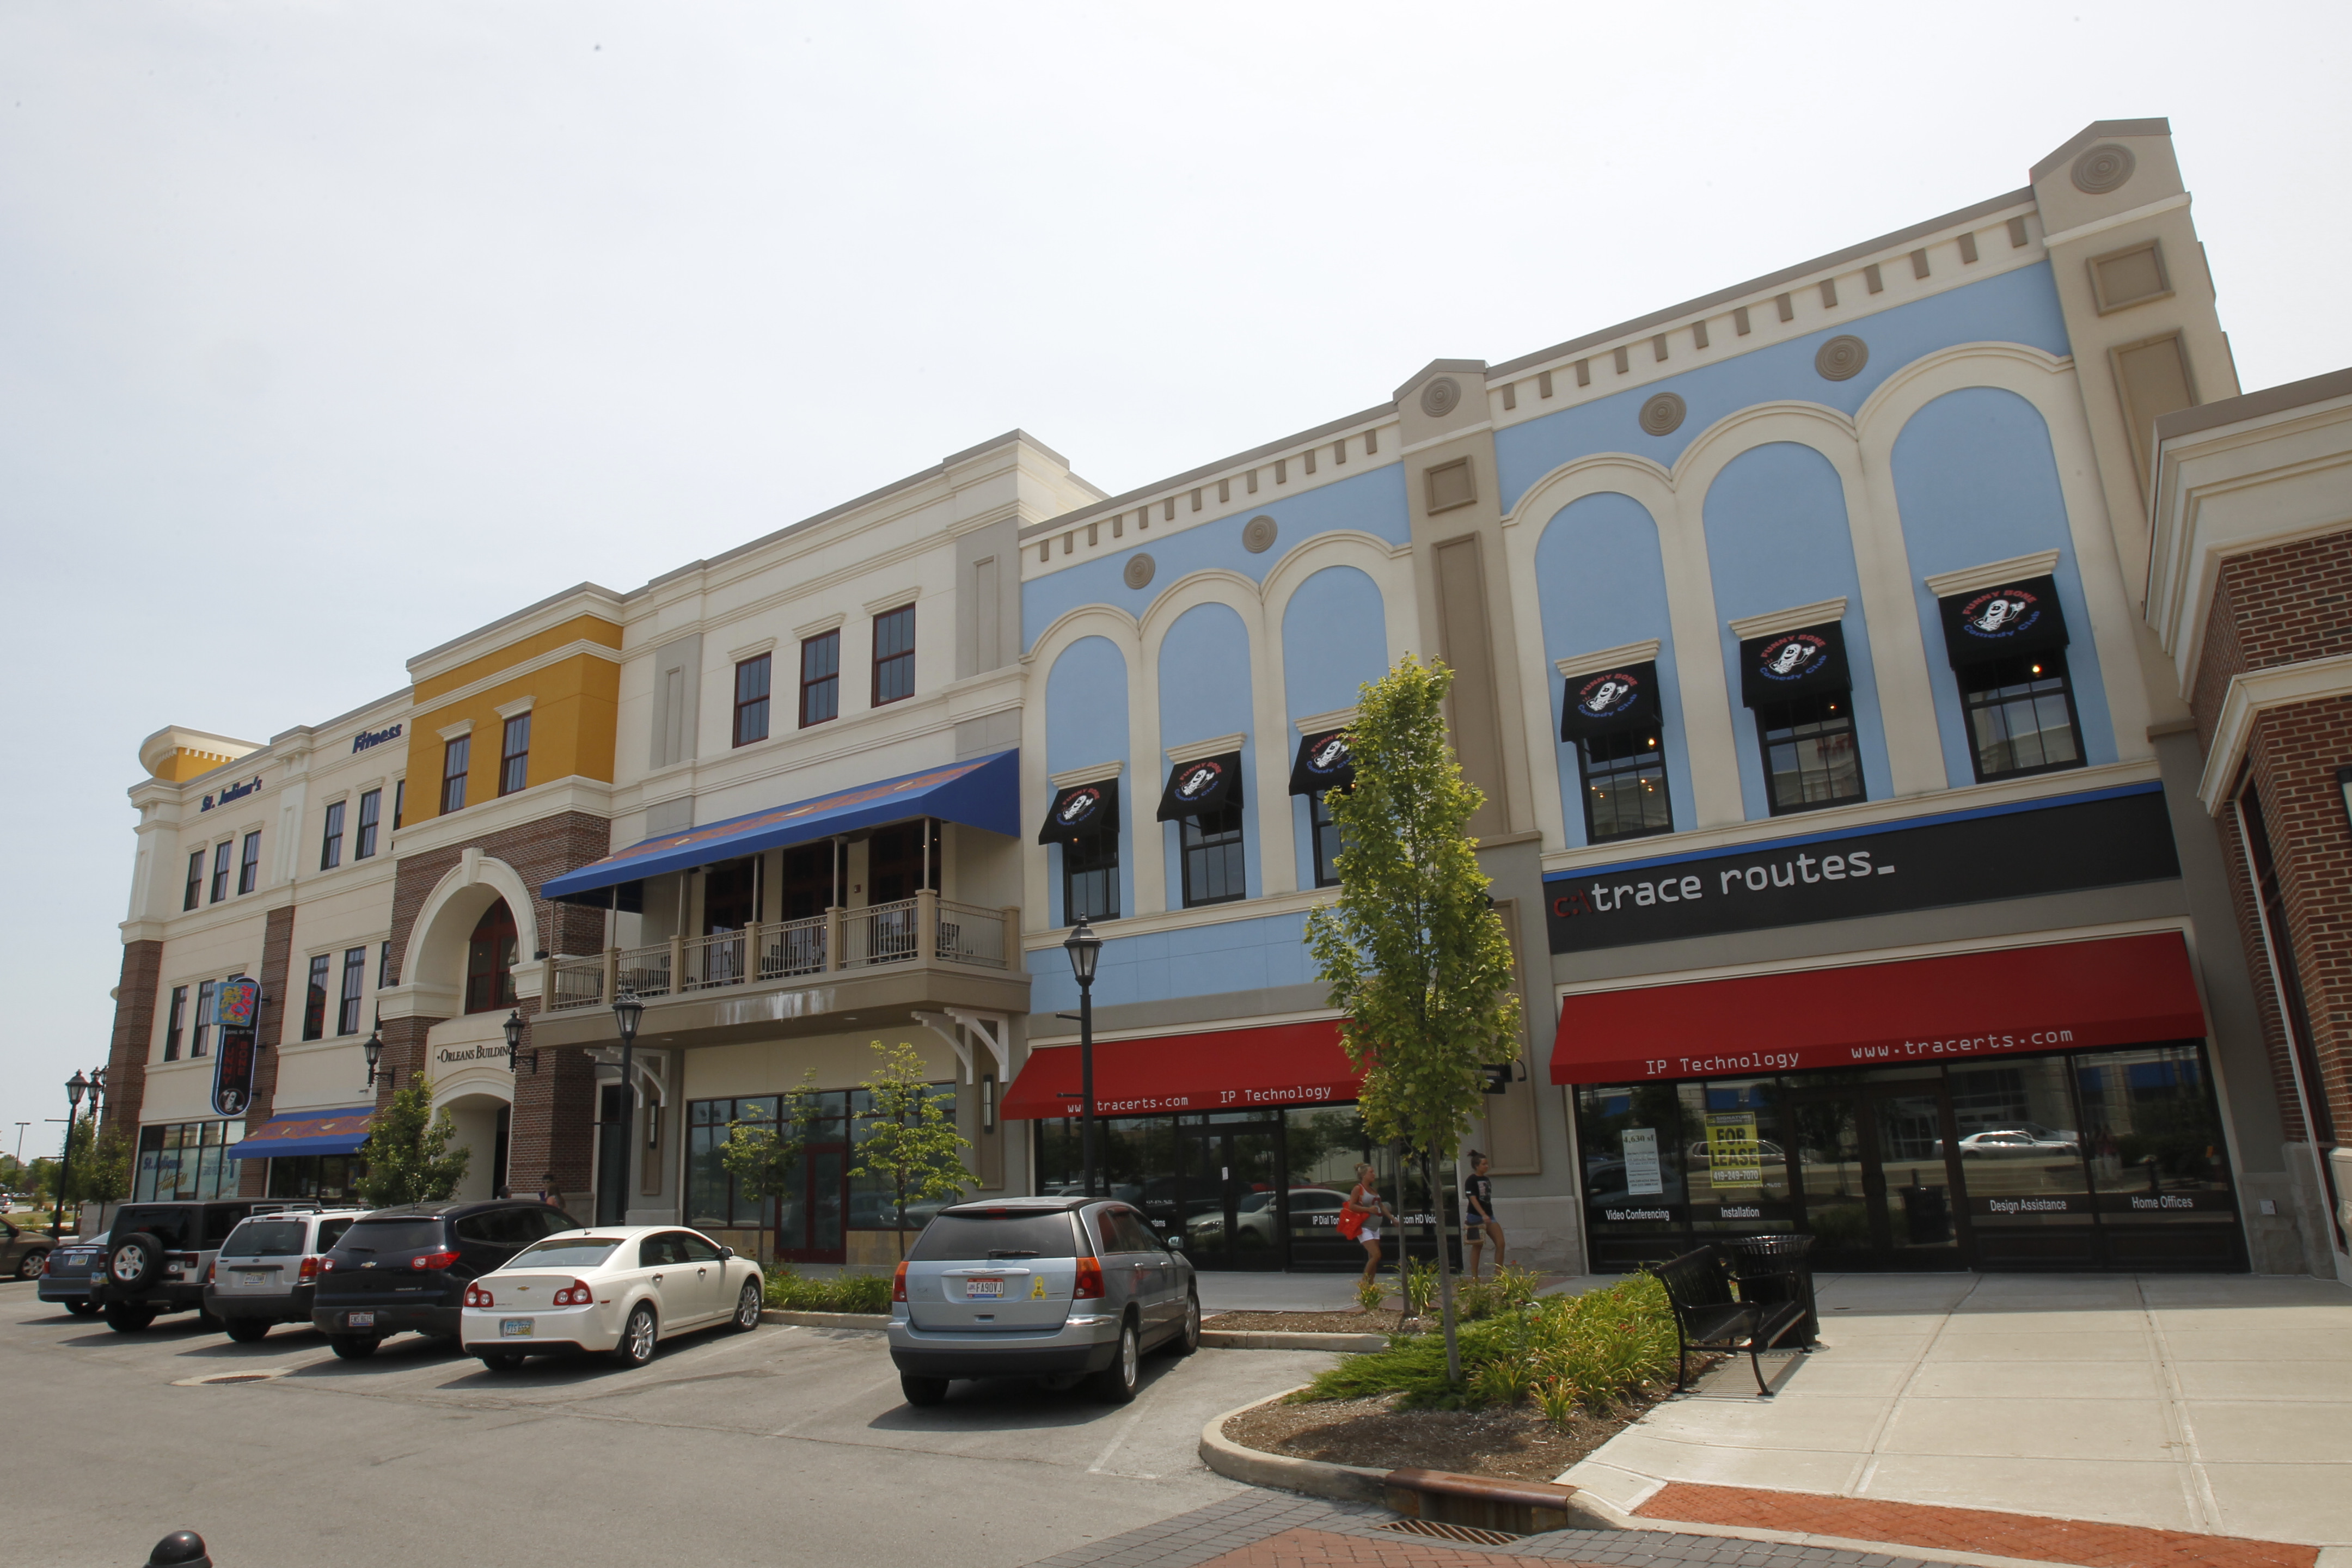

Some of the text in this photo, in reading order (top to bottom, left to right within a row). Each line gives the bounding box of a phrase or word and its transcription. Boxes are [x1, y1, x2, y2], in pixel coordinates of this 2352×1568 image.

[1962, 590, 2038, 614] FUNNY BONE
[1963, 610, 2041, 638] Comedy Club
[1760, 634, 1827, 658] FUNNY BONE
[1760, 655, 1827, 681] Comedy Club
[1580, 673, 1638, 695] FUNNY BONE
[1578, 694, 1637, 717] Comedy Club
[352, 724, 402, 754] Fitness
[1179, 762, 1222, 780] FUNNY BONE
[1307, 761, 1334, 773] Comedy
[200, 776, 262, 812] St. Julian's
[1062, 788, 1088, 805] FUNNY
[1174, 789, 1199, 801] Comedy
[1851, 1028, 2073, 1059] www.tracerts.com
[440, 1049, 475, 1062] ORLEANS
[1646, 1051, 1799, 1075] IP Technology
[1220, 1086, 1331, 1103] IP Technology
[1624, 1135, 1645, 1143] 4,630
[1716, 1128, 1747, 1146] FOR
[1710, 1148, 1759, 1166] LEASE
[1713, 1170, 1759, 1180] 419-249-7070
[1990, 1199, 2067, 1214] Design Assistance
[2132, 1195, 2193, 1209] Home Offices
[1312, 1215, 1318, 1224] IP
[1319, 1215, 1329, 1224] Dial
[1415, 1214, 1424, 1223] HD
[1606, 1208, 1670, 1221] Video Conferencing
[1720, 1206, 1760, 1218] Installation
